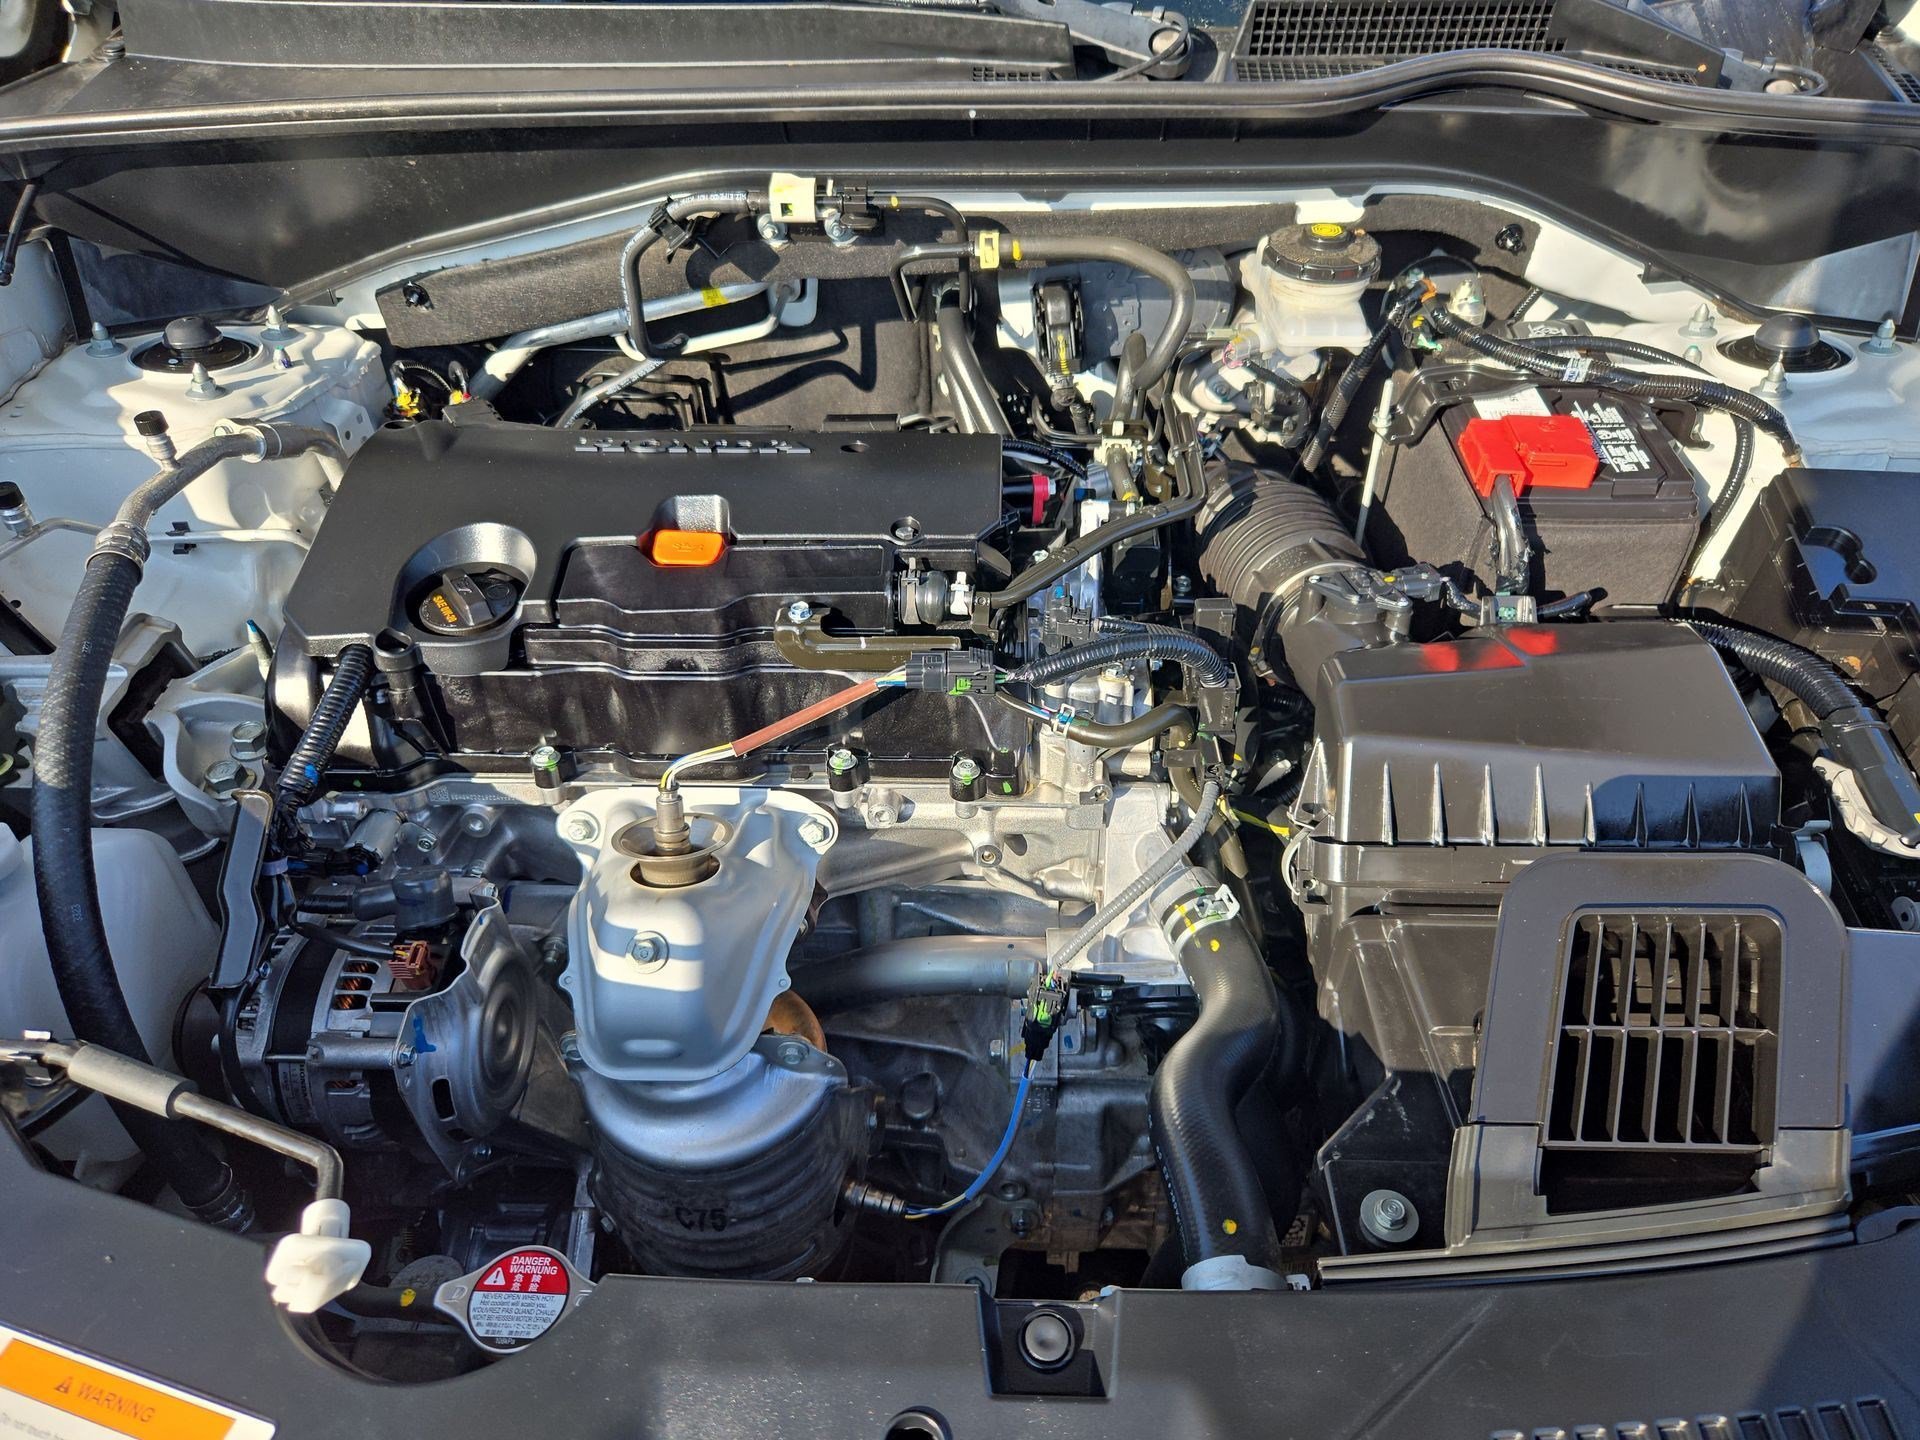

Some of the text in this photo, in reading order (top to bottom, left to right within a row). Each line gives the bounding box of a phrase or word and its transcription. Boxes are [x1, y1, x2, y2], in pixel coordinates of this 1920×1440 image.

[511, 1256, 551, 1265] DANGER
[509, 1265, 558, 1274] WARNUNG
[78, 1382, 156, 1422] WARNING
